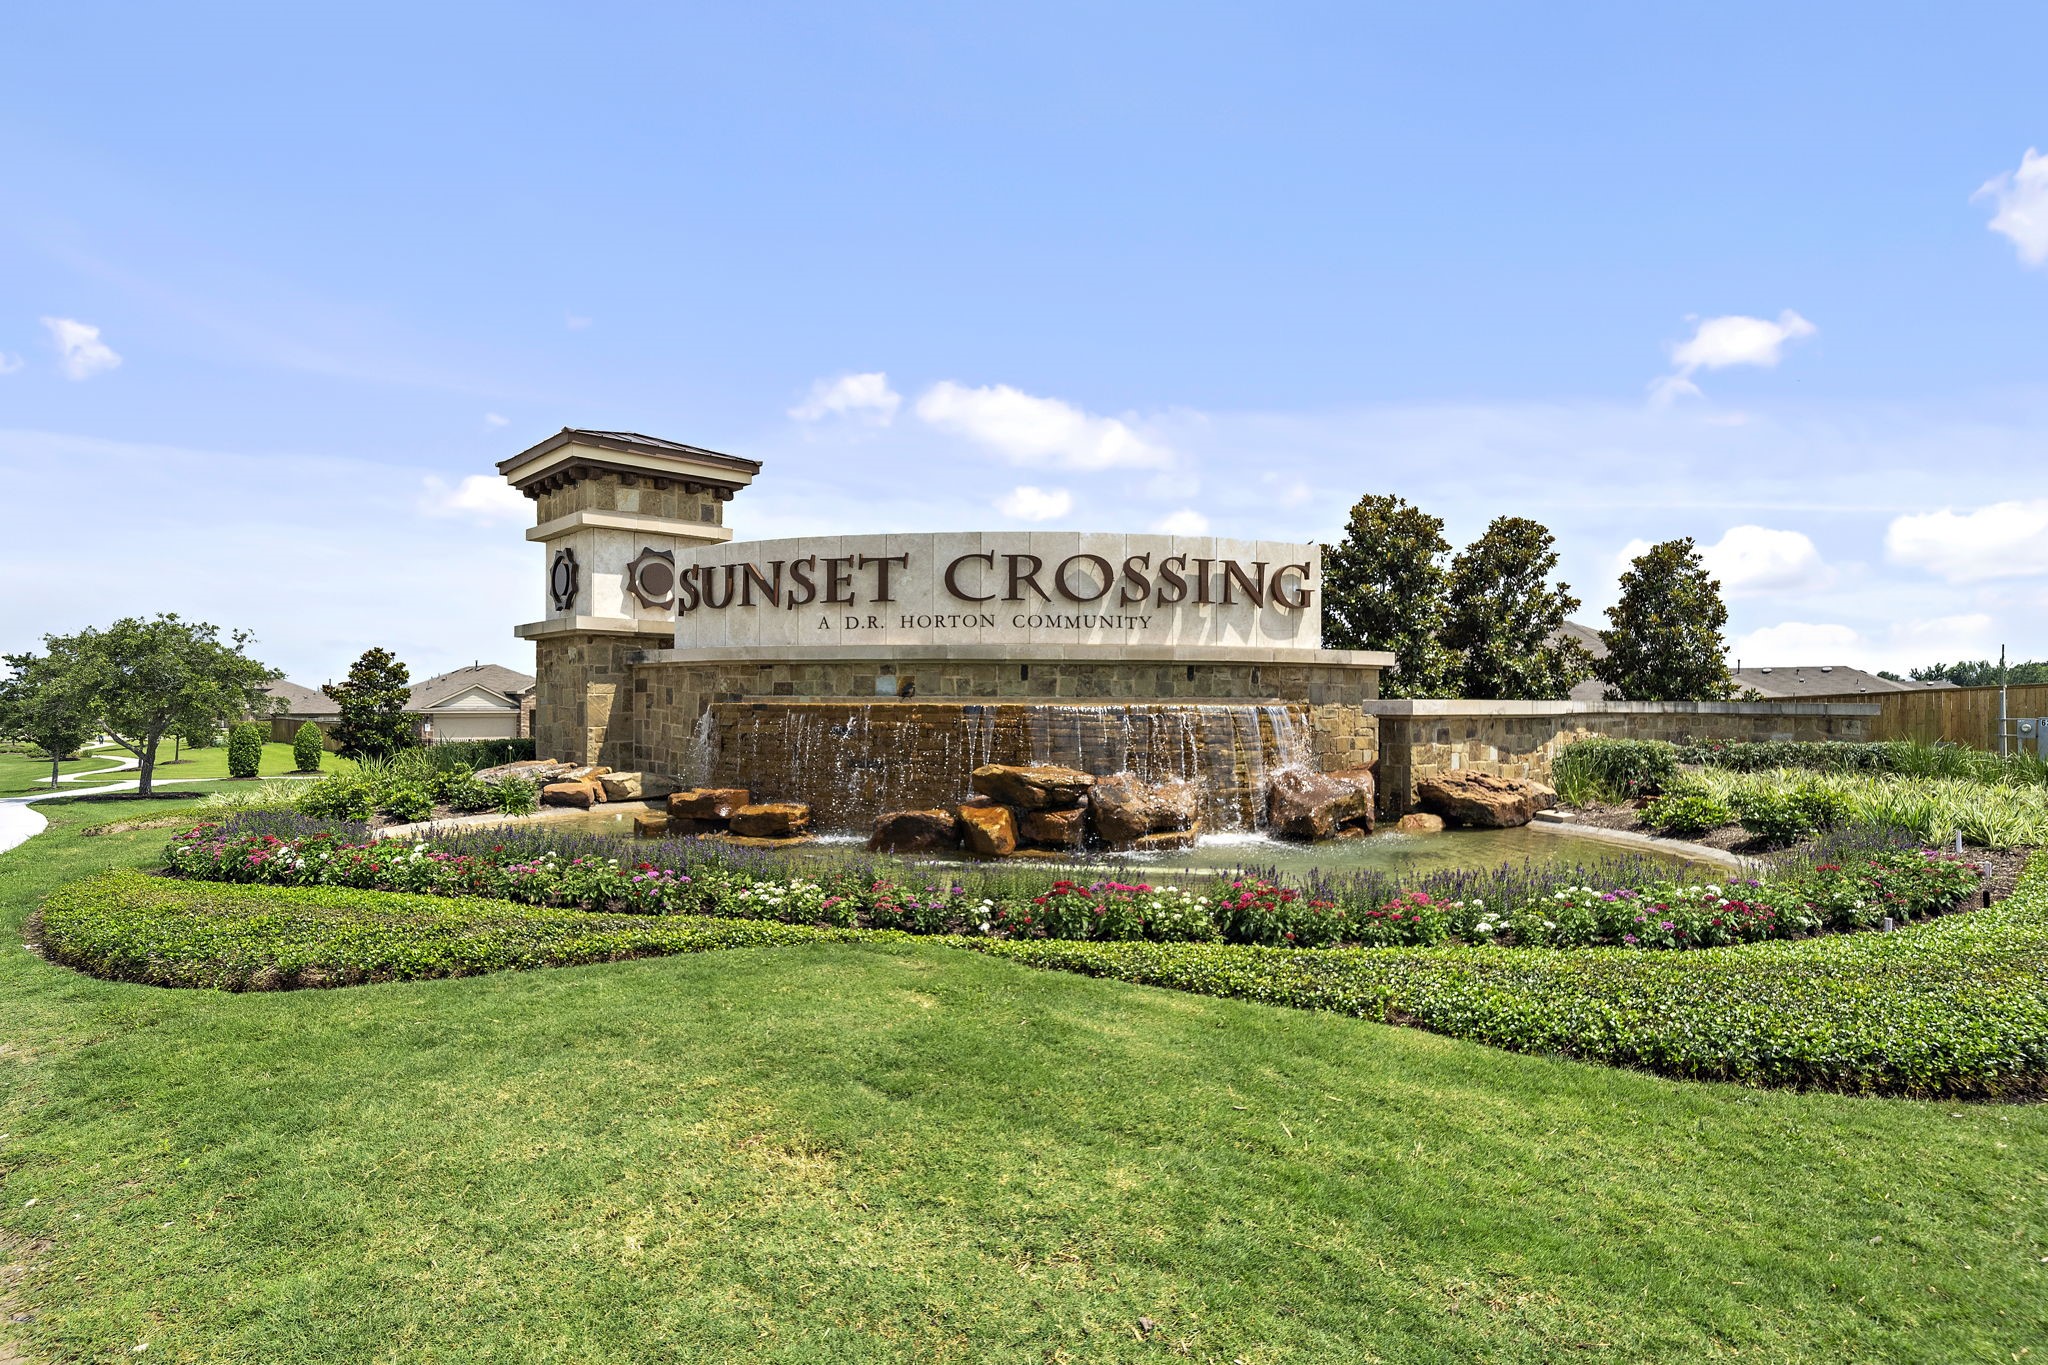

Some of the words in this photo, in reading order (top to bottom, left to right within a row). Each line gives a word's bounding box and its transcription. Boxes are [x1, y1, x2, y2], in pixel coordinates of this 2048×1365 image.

[678, 552, 910, 616] SUNSET
[944, 549, 1316, 610] CROSSING
[817, 616, 831, 630] A
[845, 615, 885, 630] D.R.
[900, 614, 996, 629] HORTON
[1012, 614, 1153, 630] COMMUNITY
